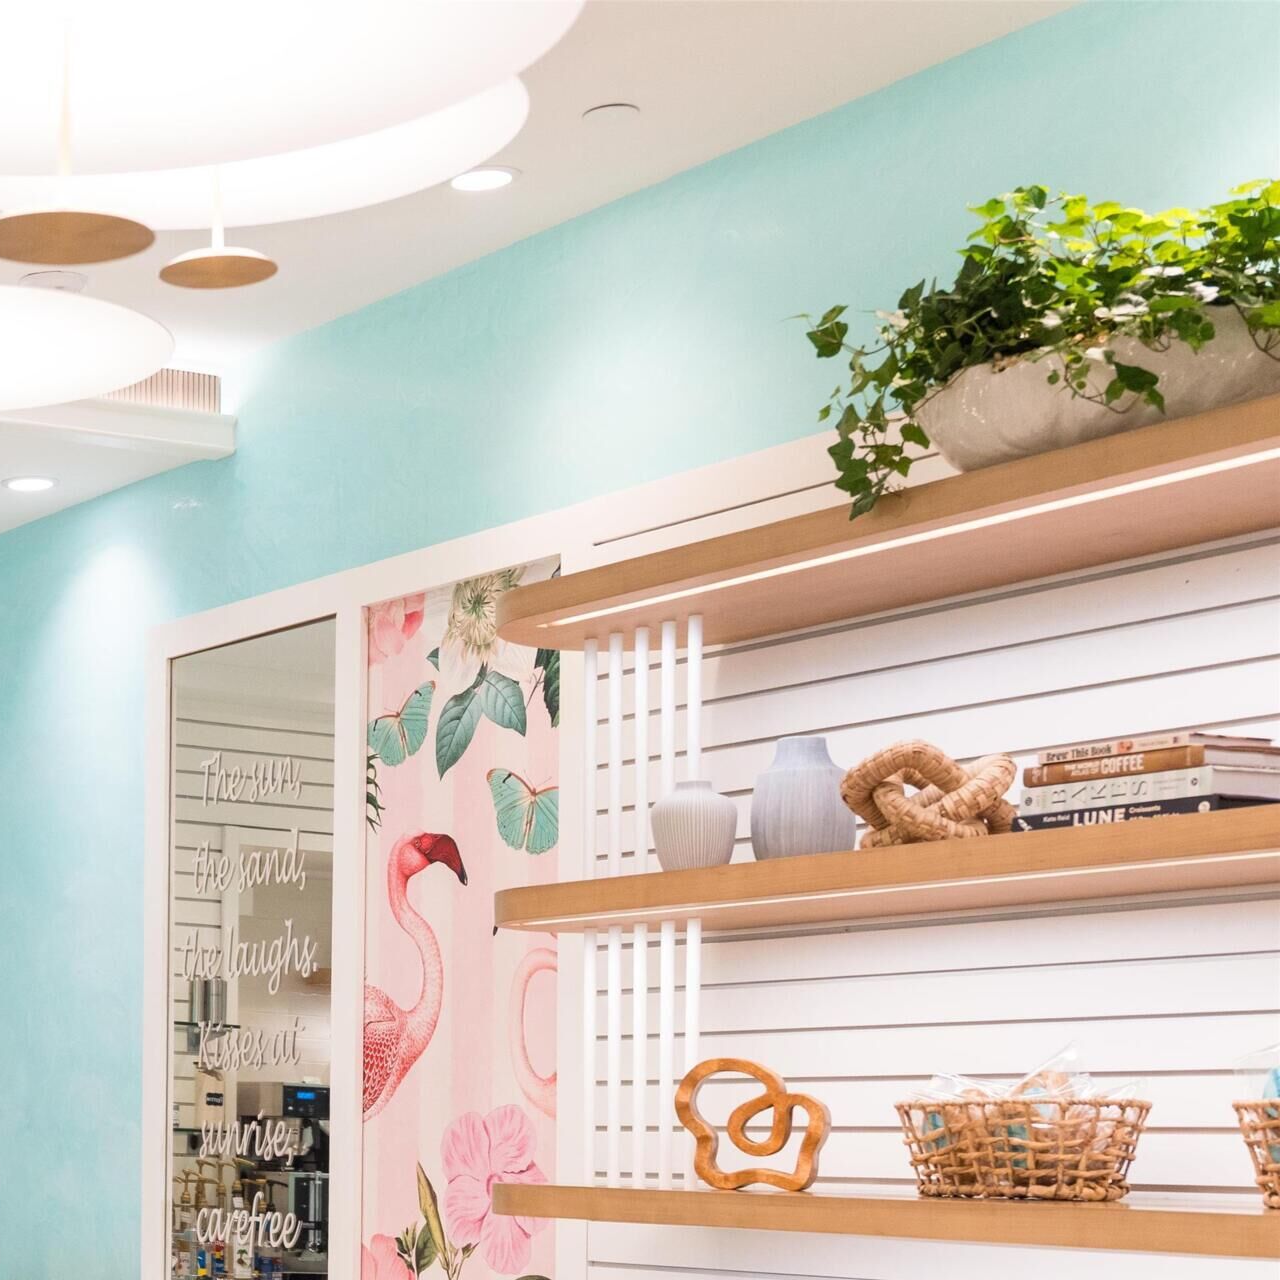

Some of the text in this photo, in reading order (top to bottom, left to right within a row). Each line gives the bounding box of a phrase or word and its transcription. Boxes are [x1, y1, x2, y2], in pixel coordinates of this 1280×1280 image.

[200, 751, 303, 807] The sun,
[1071, 748, 1089, 759] This
[1090, 744, 1113, 756] Book
[1101, 754, 1144, 774] COFFEE
[1073, 808, 1127, 826] LUNE
[192, 827, 306, 894] the sand,
[182, 919, 318, 995] the laughs.
[198, 1017, 307, 1071] Kisses at
[199, 1109, 294, 1166] sunrise,
[197, 1191, 303, 1258] carefree
